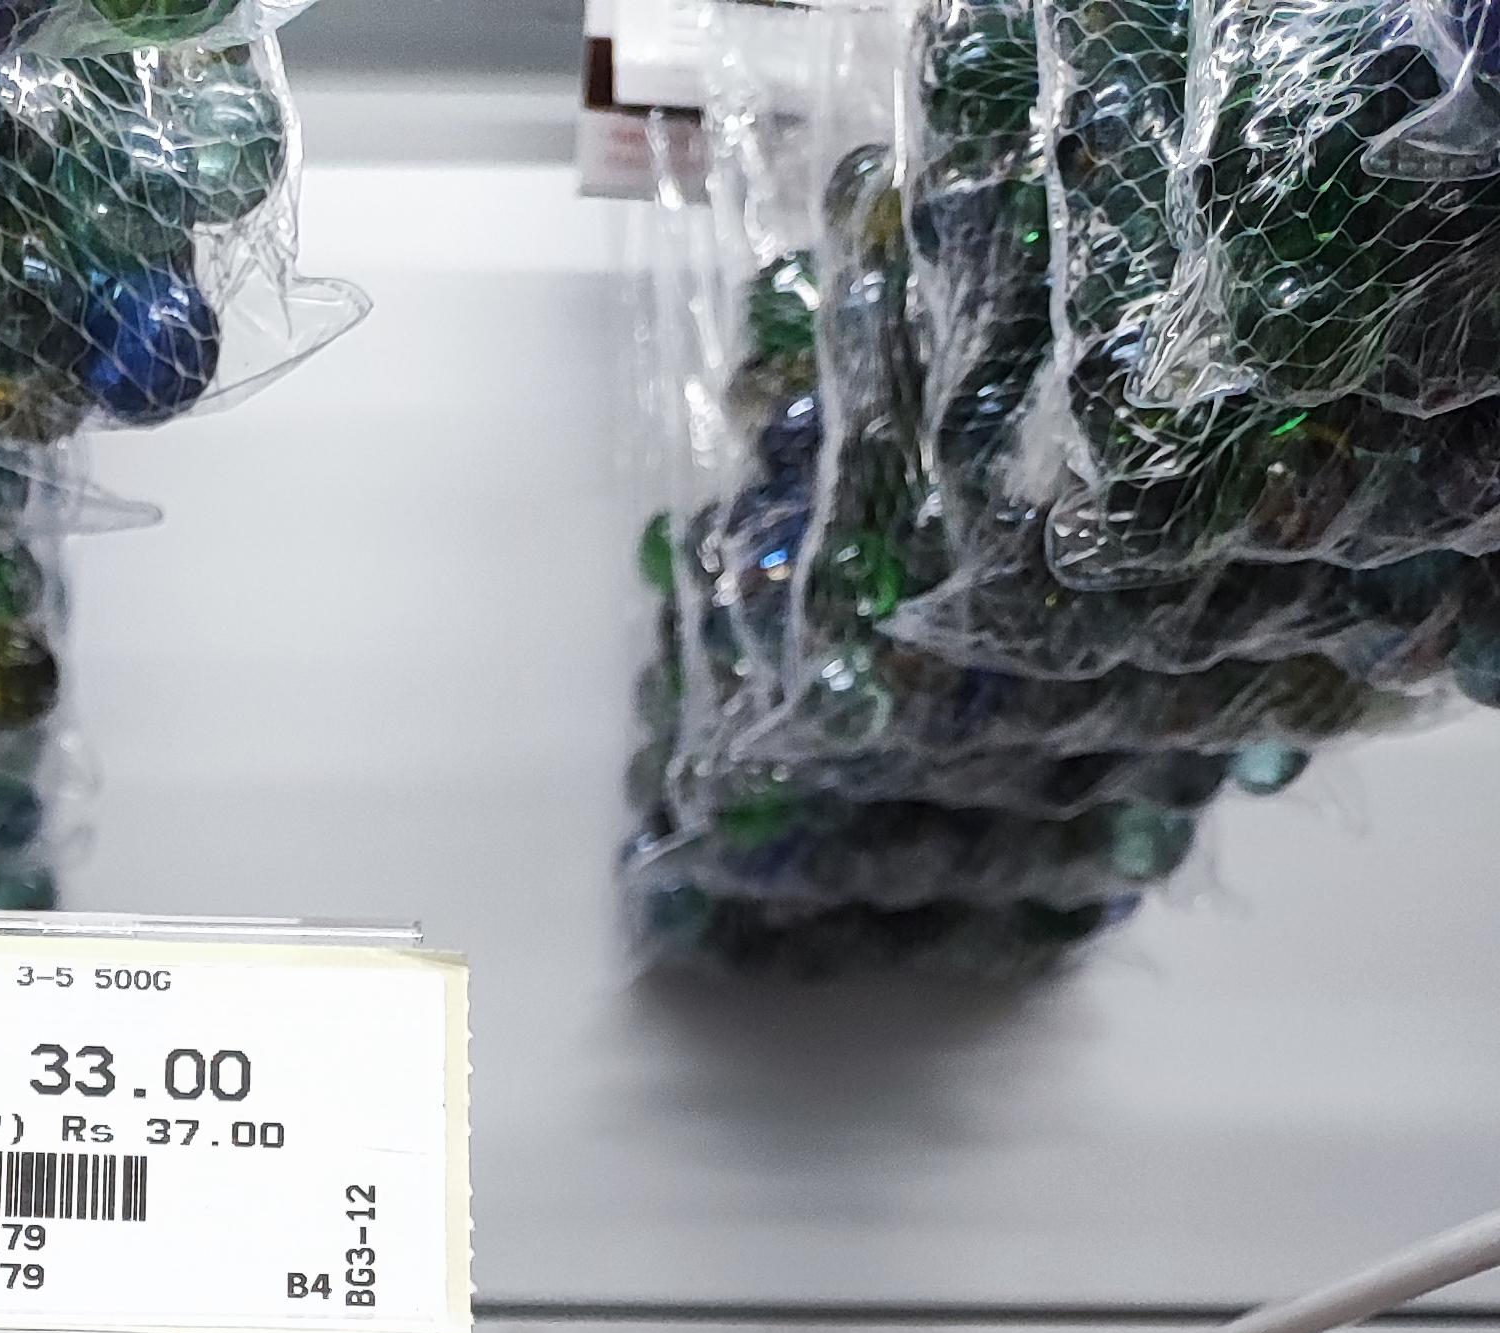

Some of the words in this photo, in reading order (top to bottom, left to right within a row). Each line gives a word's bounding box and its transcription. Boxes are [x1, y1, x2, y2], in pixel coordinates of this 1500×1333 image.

[16, 966, 74, 988] 3-5
[94, 968, 172, 992] 500G
[29, 1043, 252, 1102] 33.00
[61, 1115, 114, 1143] Rs
[146, 1118, 285, 1149] 37.00
[345, 1184, 376, 1307] BG3-12
[287, 1272, 333, 1300] B4
